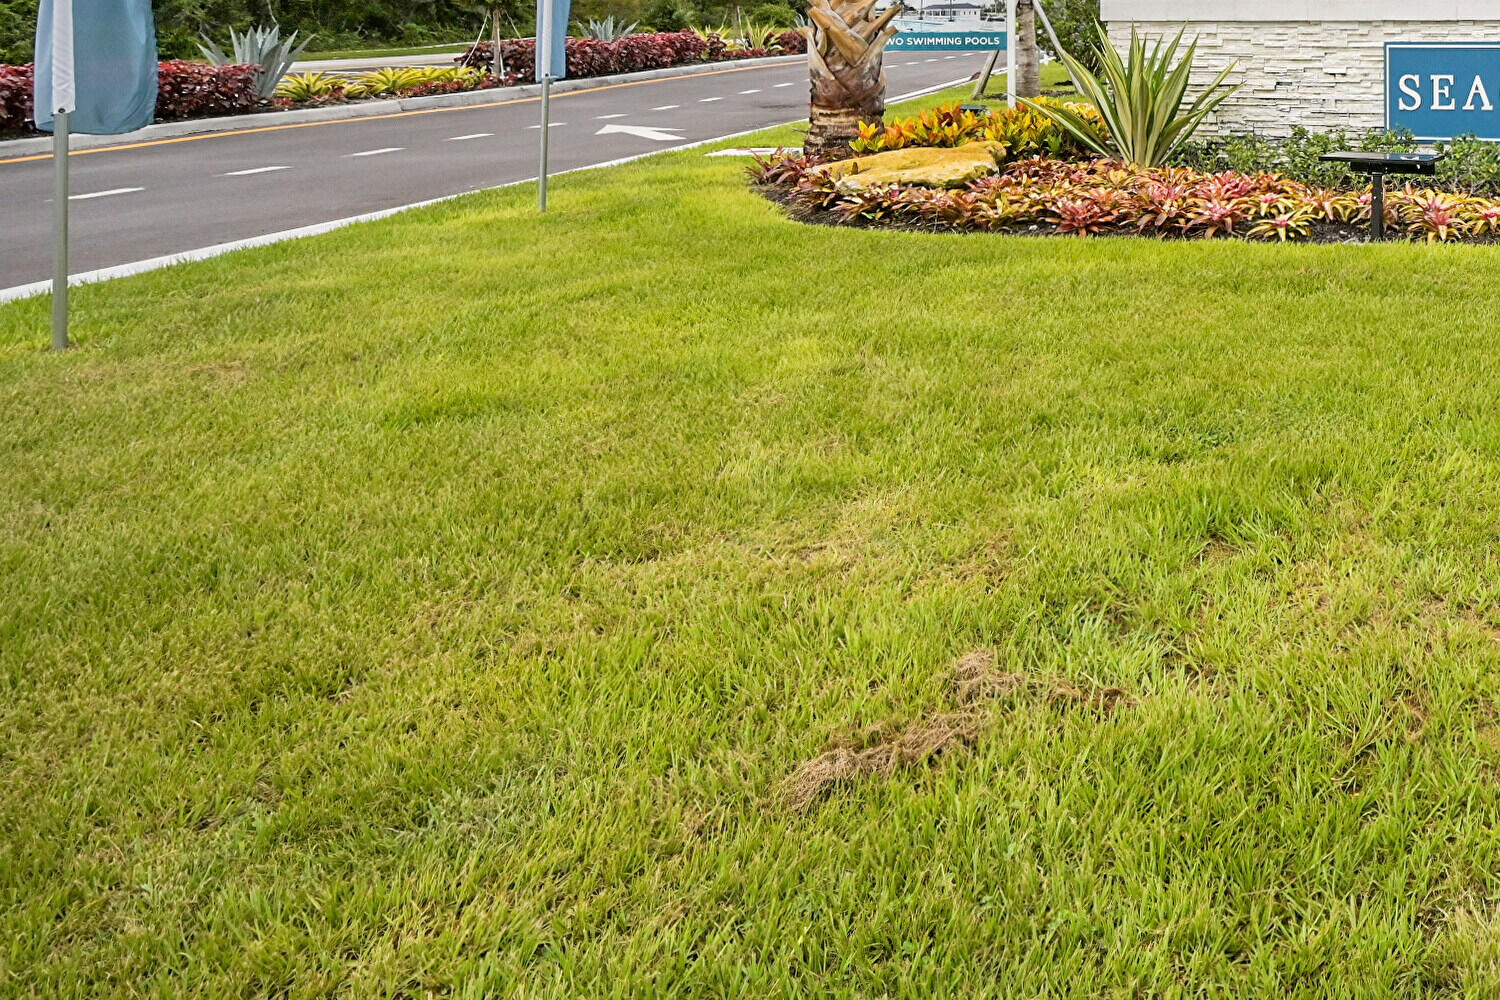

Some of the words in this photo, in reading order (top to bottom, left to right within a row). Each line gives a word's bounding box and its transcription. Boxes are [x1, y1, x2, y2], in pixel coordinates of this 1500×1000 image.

[885, 38, 904, 46] WO
[906, 37, 962, 46] SWIMMING
[964, 36, 1000, 46] POOLS
